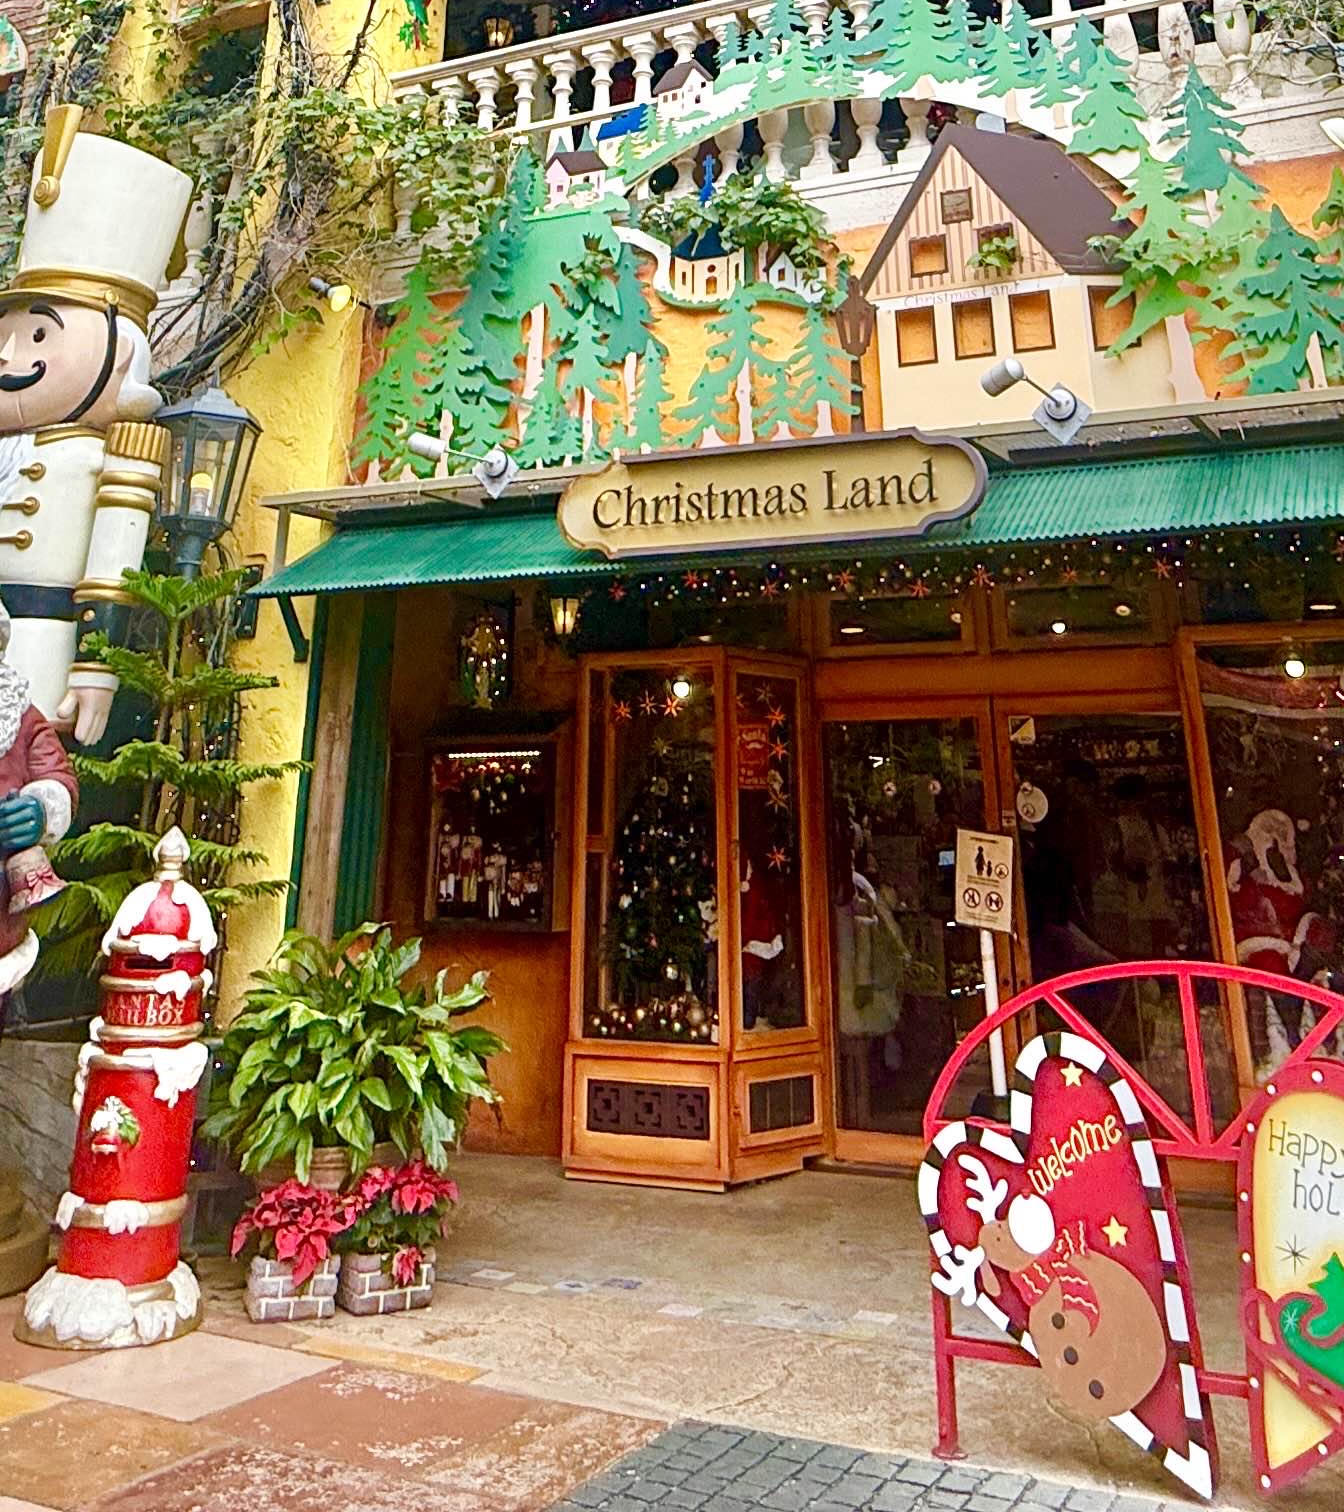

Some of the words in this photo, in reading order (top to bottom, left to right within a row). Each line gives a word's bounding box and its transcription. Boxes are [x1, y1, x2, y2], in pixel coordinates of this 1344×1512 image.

[903, 289, 977, 307] Christmas
[592, 480, 807, 531] Christmas
[822, 457, 940, 512] Land
